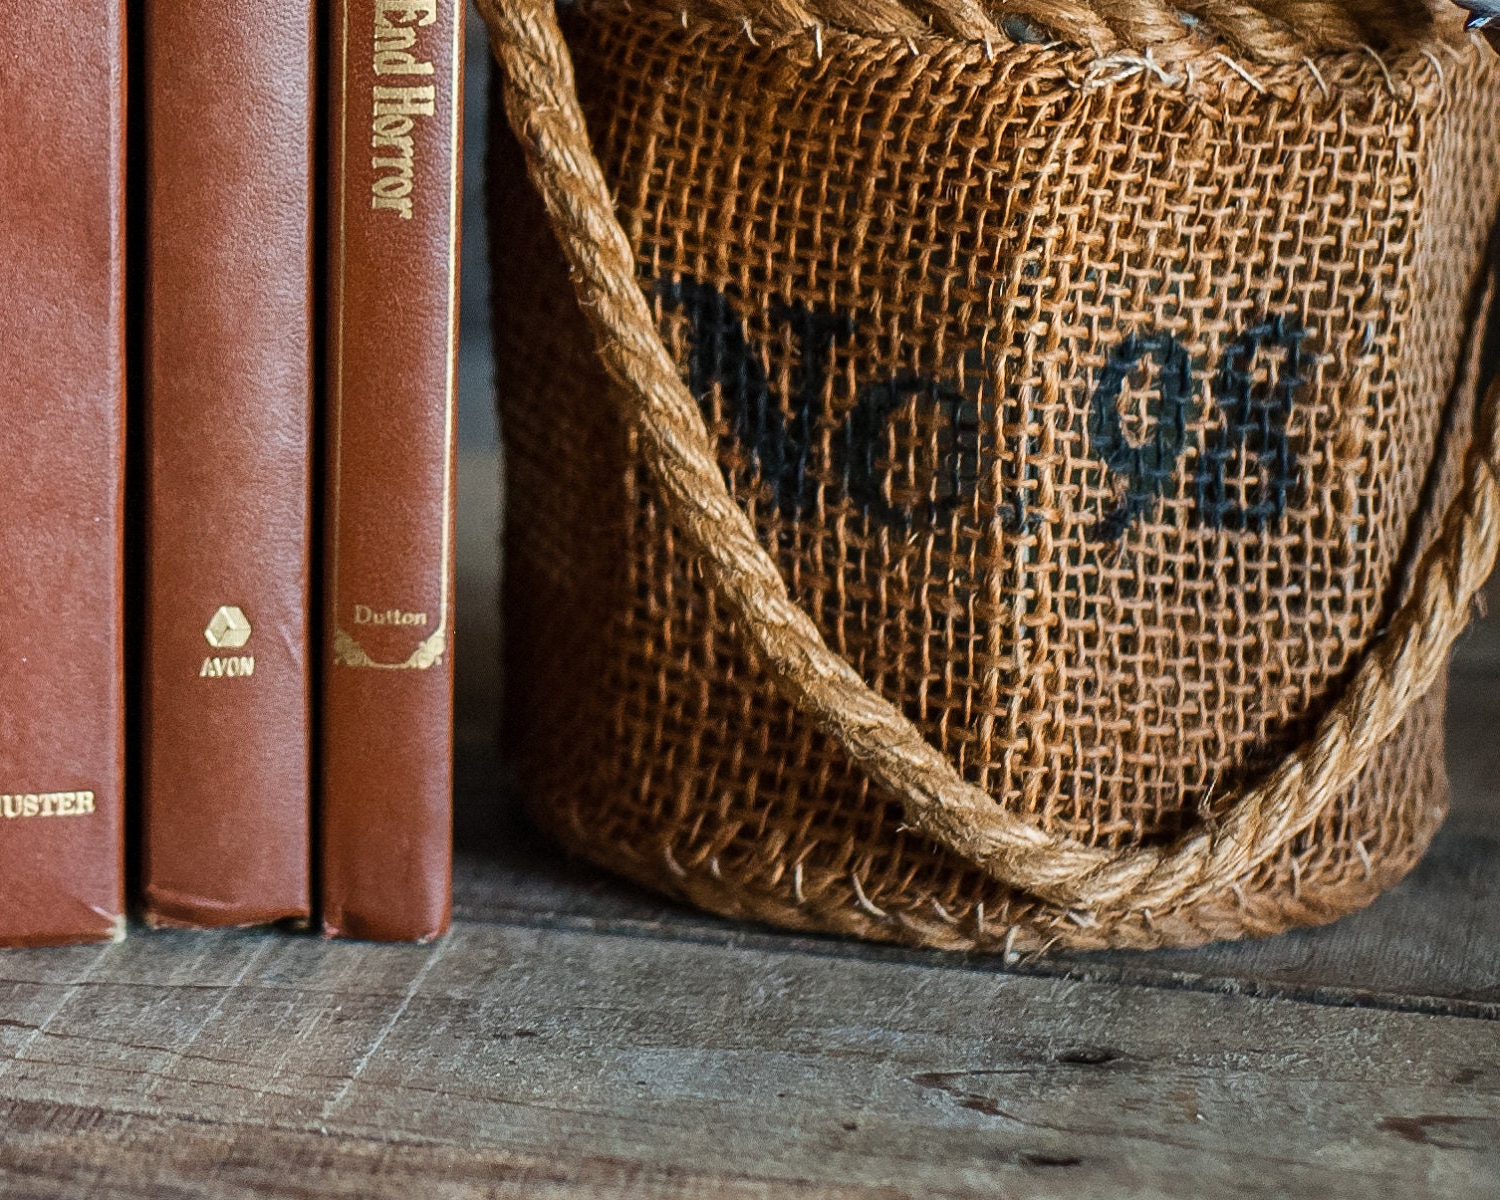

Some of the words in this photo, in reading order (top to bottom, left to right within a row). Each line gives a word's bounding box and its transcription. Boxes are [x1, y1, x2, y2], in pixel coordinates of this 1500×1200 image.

[371, 83, 437, 221] Horror
[1090, 315, 1315, 540] 98
[353, 604, 428, 626] Dutton
[199, 656, 256, 677] AVON
